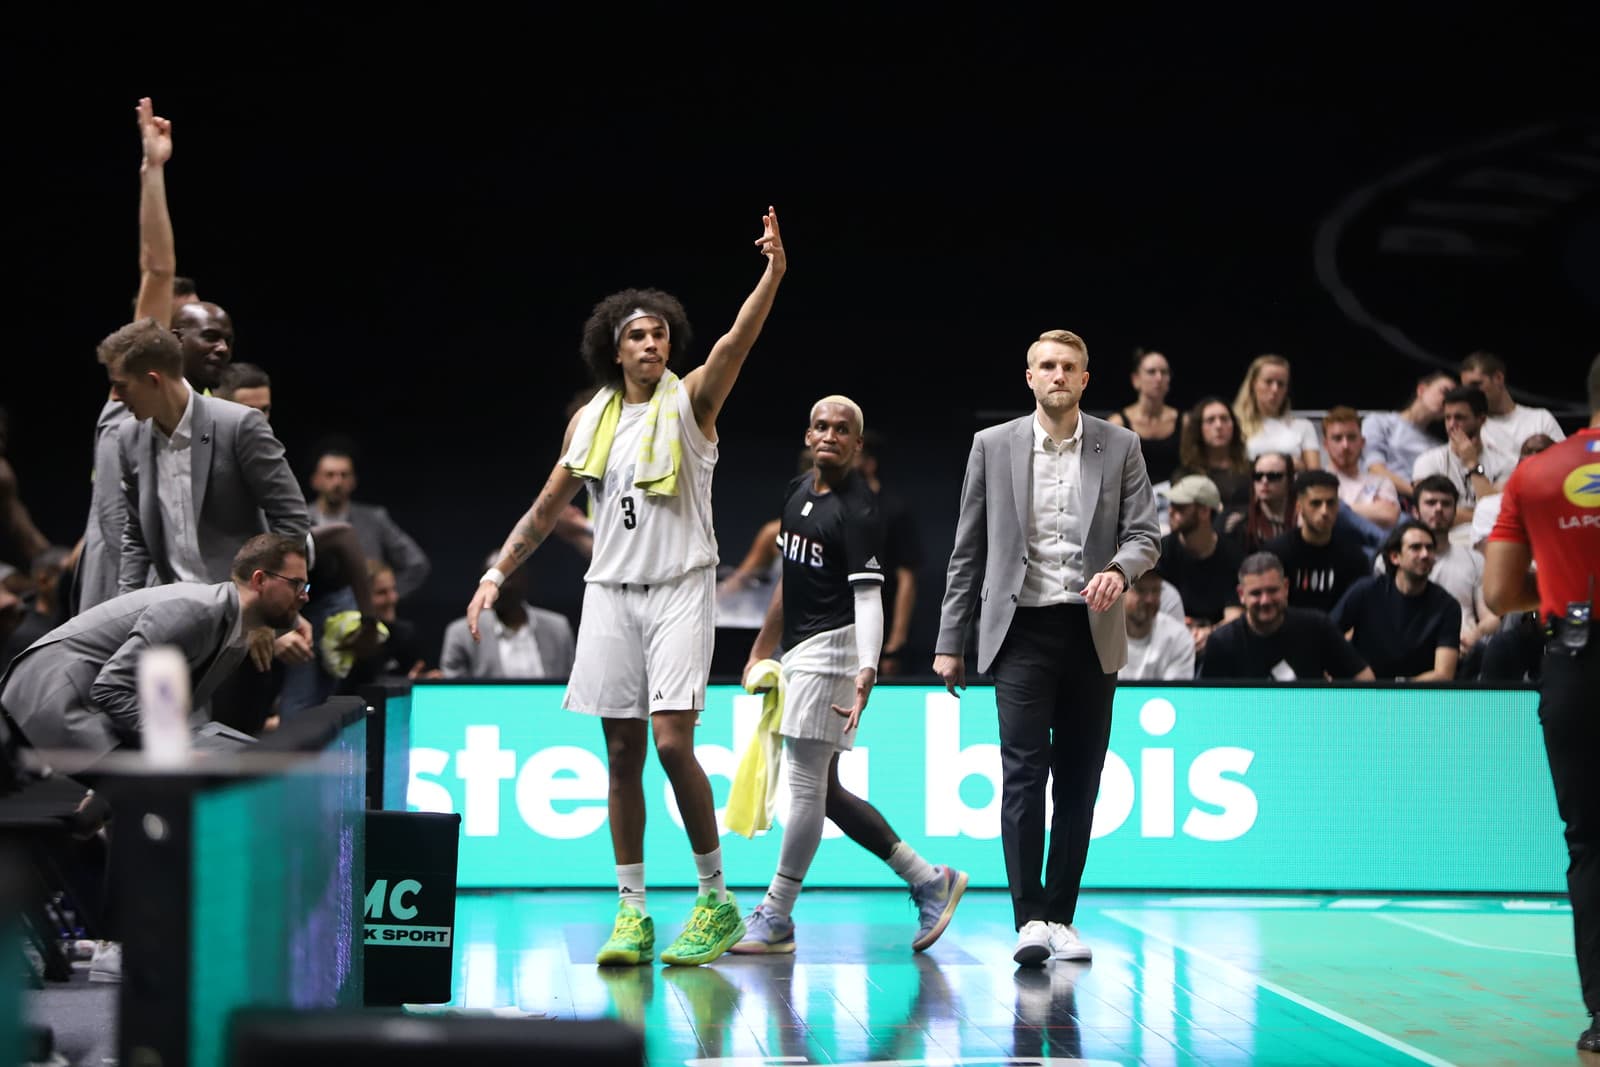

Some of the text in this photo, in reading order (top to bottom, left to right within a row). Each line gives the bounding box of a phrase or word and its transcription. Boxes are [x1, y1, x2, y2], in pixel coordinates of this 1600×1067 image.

[621, 496, 636, 530] 3
[1558, 515, 1581, 529] LA
[382, 929, 448, 942] SPORT
